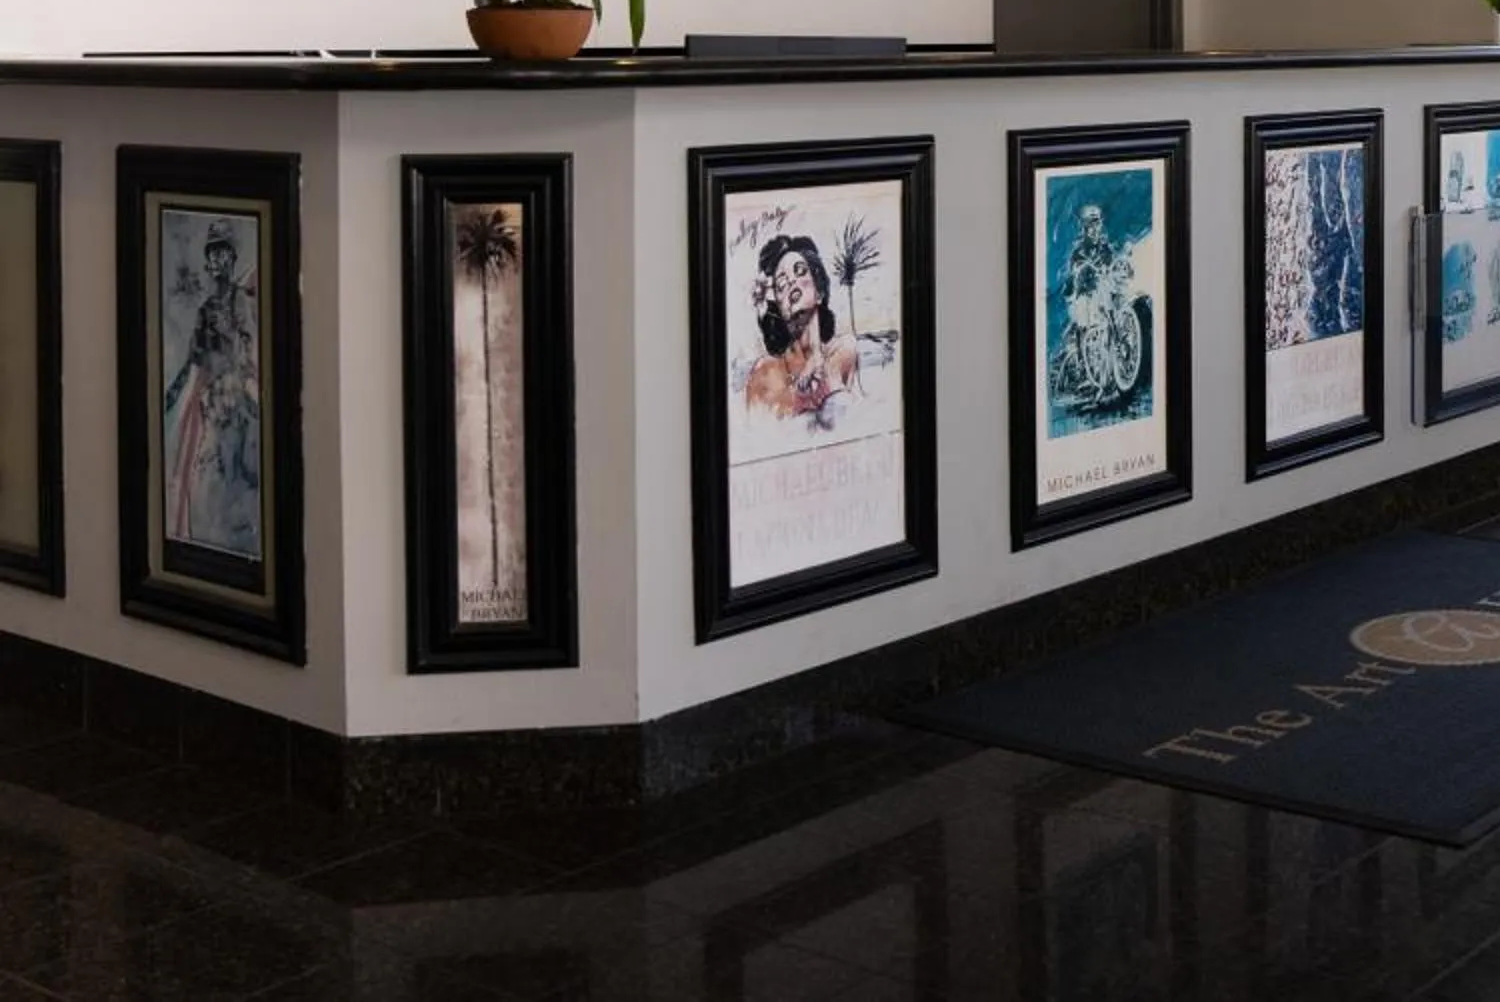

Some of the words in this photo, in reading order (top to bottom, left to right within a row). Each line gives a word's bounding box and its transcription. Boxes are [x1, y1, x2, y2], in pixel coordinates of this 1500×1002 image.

[1046, 466, 1107, 493] MICHAEL
[1142, 709, 1312, 763] The
[1294, 661, 1417, 709] Art
